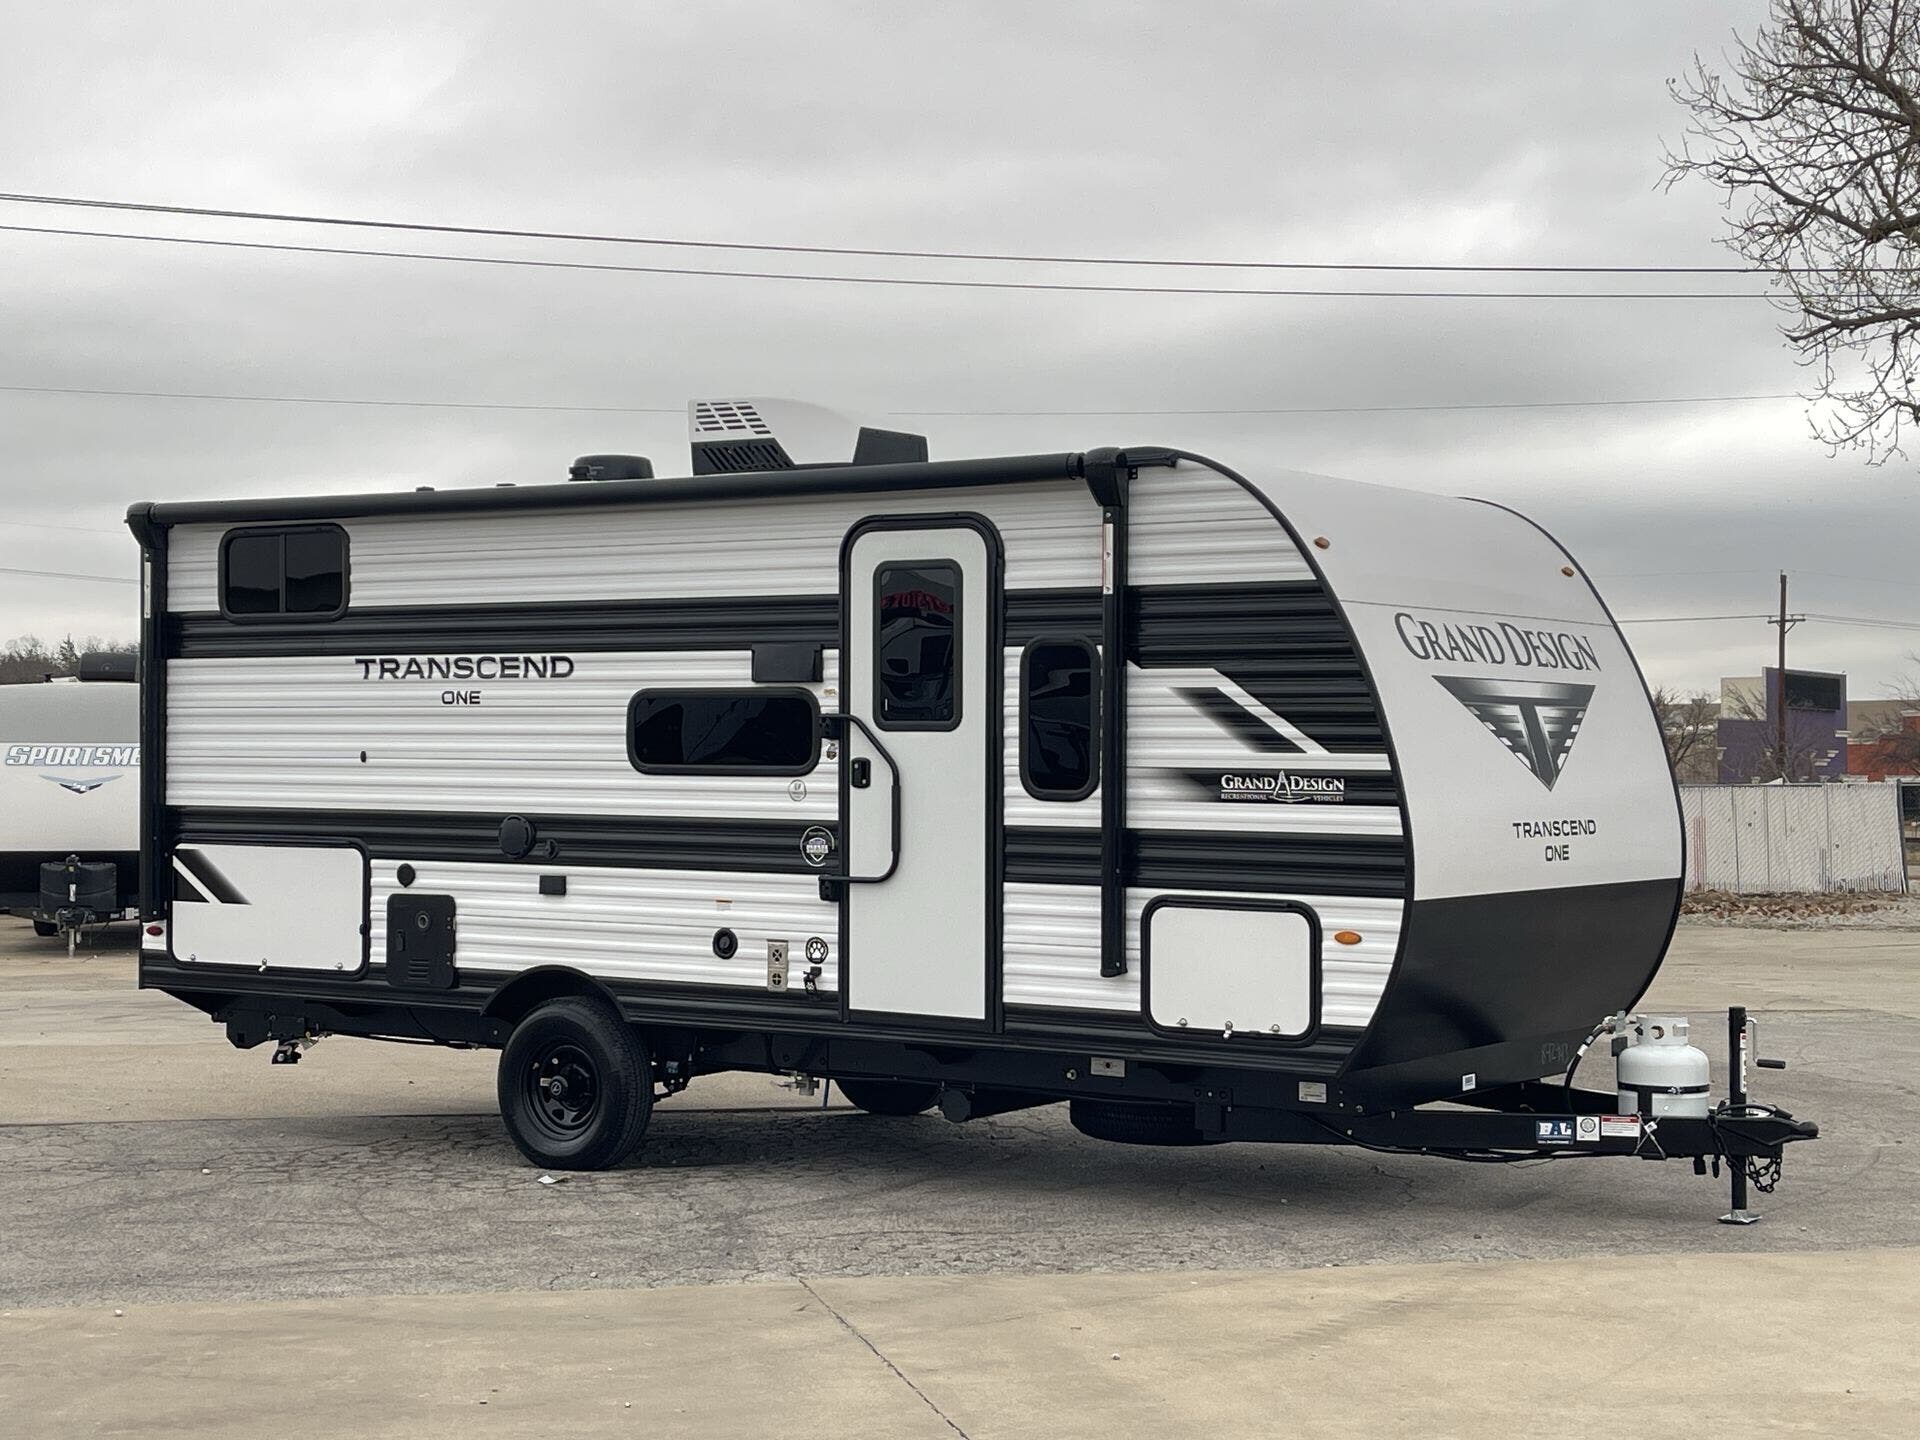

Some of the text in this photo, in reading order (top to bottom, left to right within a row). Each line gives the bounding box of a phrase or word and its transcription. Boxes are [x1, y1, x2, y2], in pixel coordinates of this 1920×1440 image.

[1394, 612, 1602, 672] GRAND DESIGN
[354, 655, 575, 680] TRANSCEND
[441, 690, 482, 705] ONE
[1221, 774, 1345, 791] GRAND DESIGN
[1512, 819, 1597, 839] TRANSCEND
[1545, 844, 1570, 862] ONE
